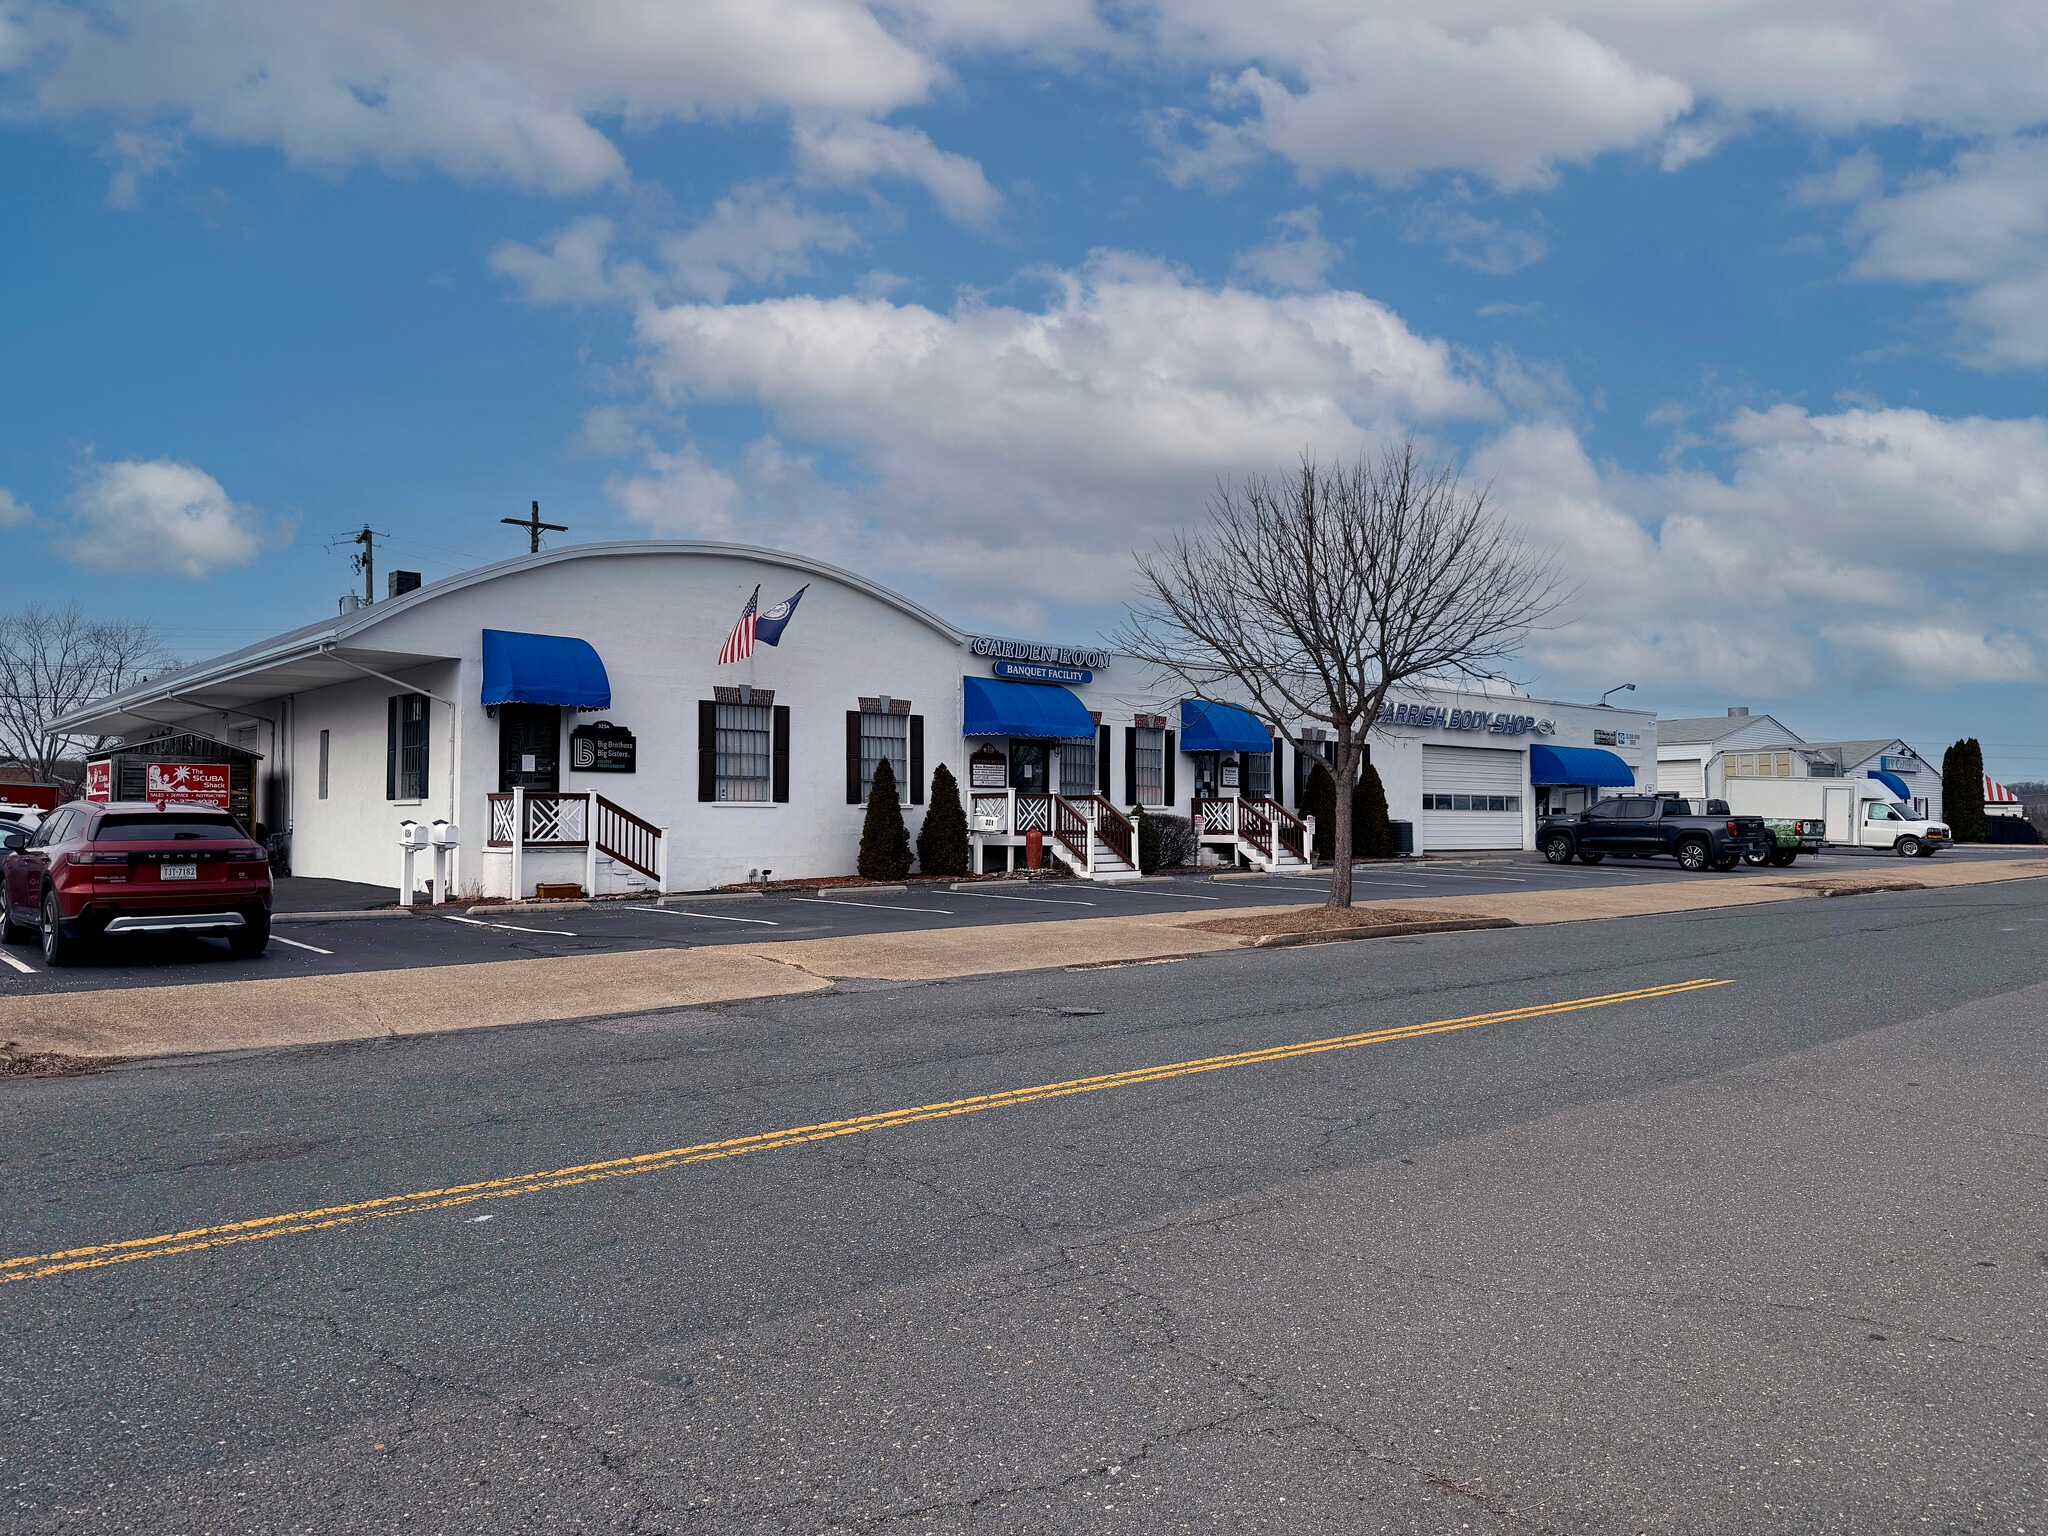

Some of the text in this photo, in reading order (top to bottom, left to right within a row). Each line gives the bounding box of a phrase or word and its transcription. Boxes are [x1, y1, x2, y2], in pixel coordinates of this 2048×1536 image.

[972, 638, 1113, 669] GARDEN ROOM
[1006, 664, 1084, 681] BANQUET FACILITY
[1376, 702, 1536, 735] PARRISH BODY SHOP
[597, 740, 633, 750] Big Brothers
[597, 749, 608, 759] Big
[1886, 758, 1920, 771] RV Collision
[192, 775, 225, 783] SCUBA
[203, 781, 226, 789] Shack
[163, 868, 195, 877] TJT-7182
